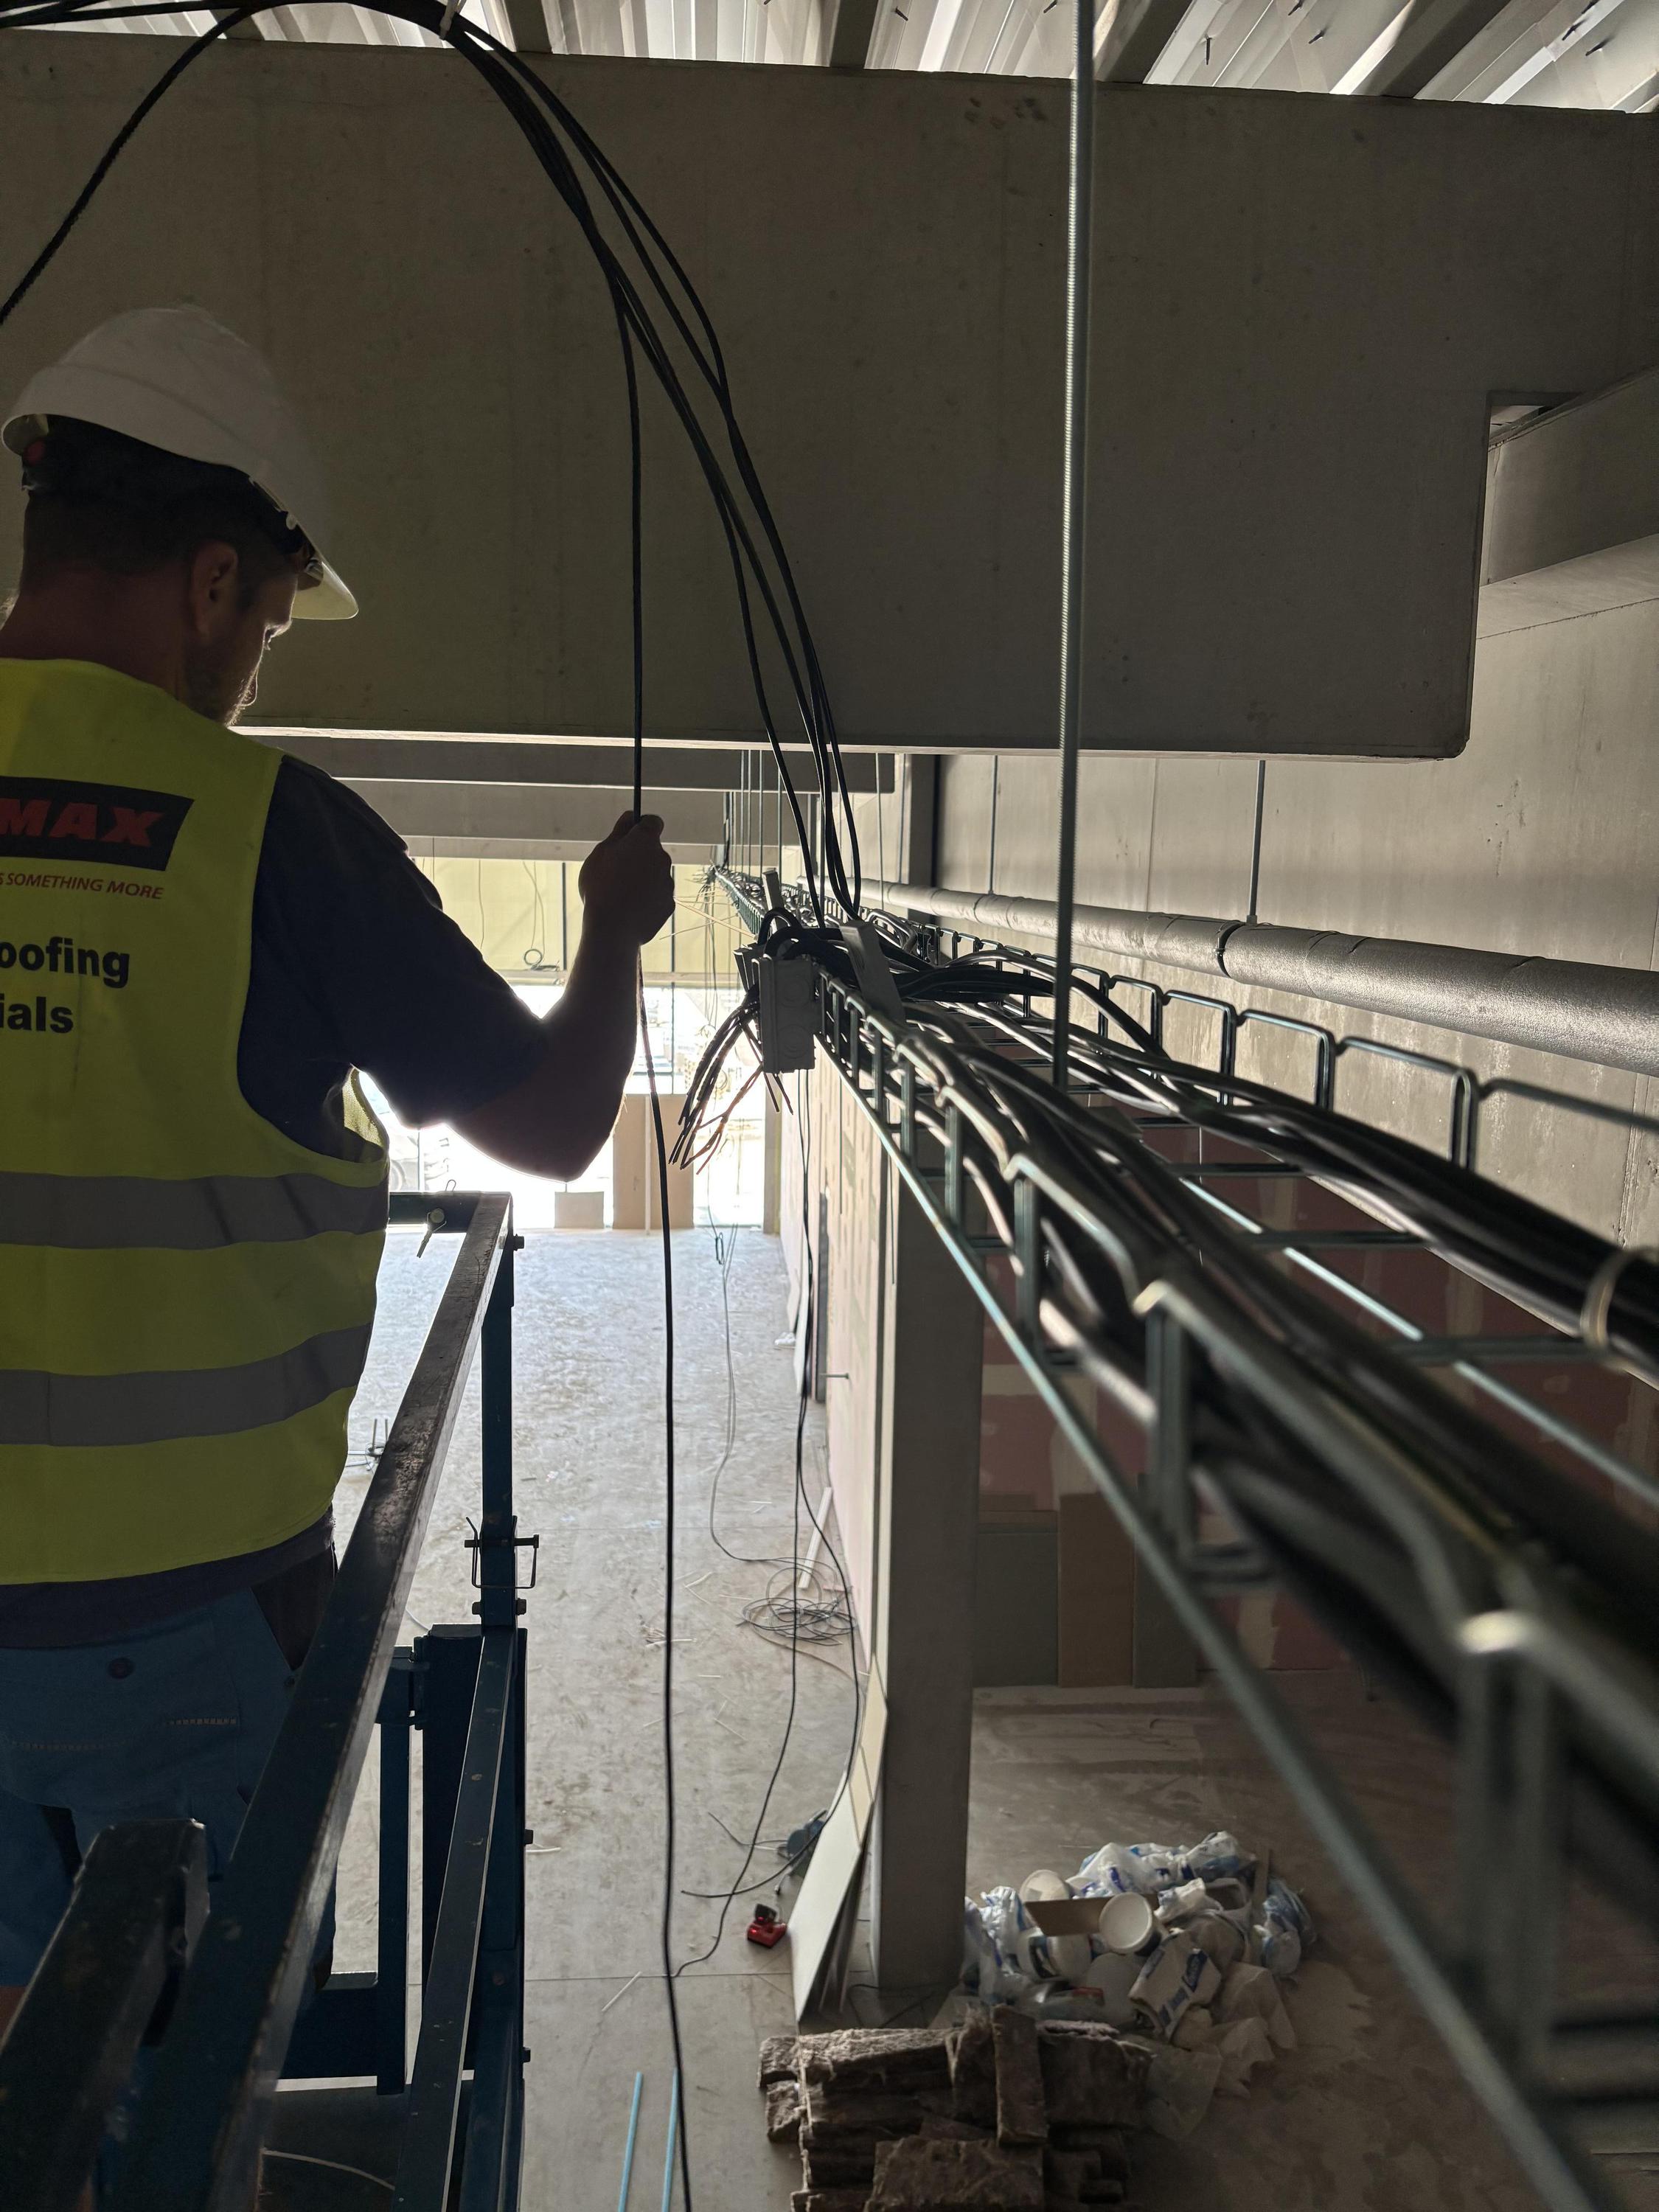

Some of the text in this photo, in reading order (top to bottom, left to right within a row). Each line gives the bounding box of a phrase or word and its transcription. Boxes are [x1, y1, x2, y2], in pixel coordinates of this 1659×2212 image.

[0, 797, 164, 847] MAX
[6, 873, 104, 891] SOMETHING
[107, 881, 164, 899] MORE
[0, 936, 130, 988] oofing
